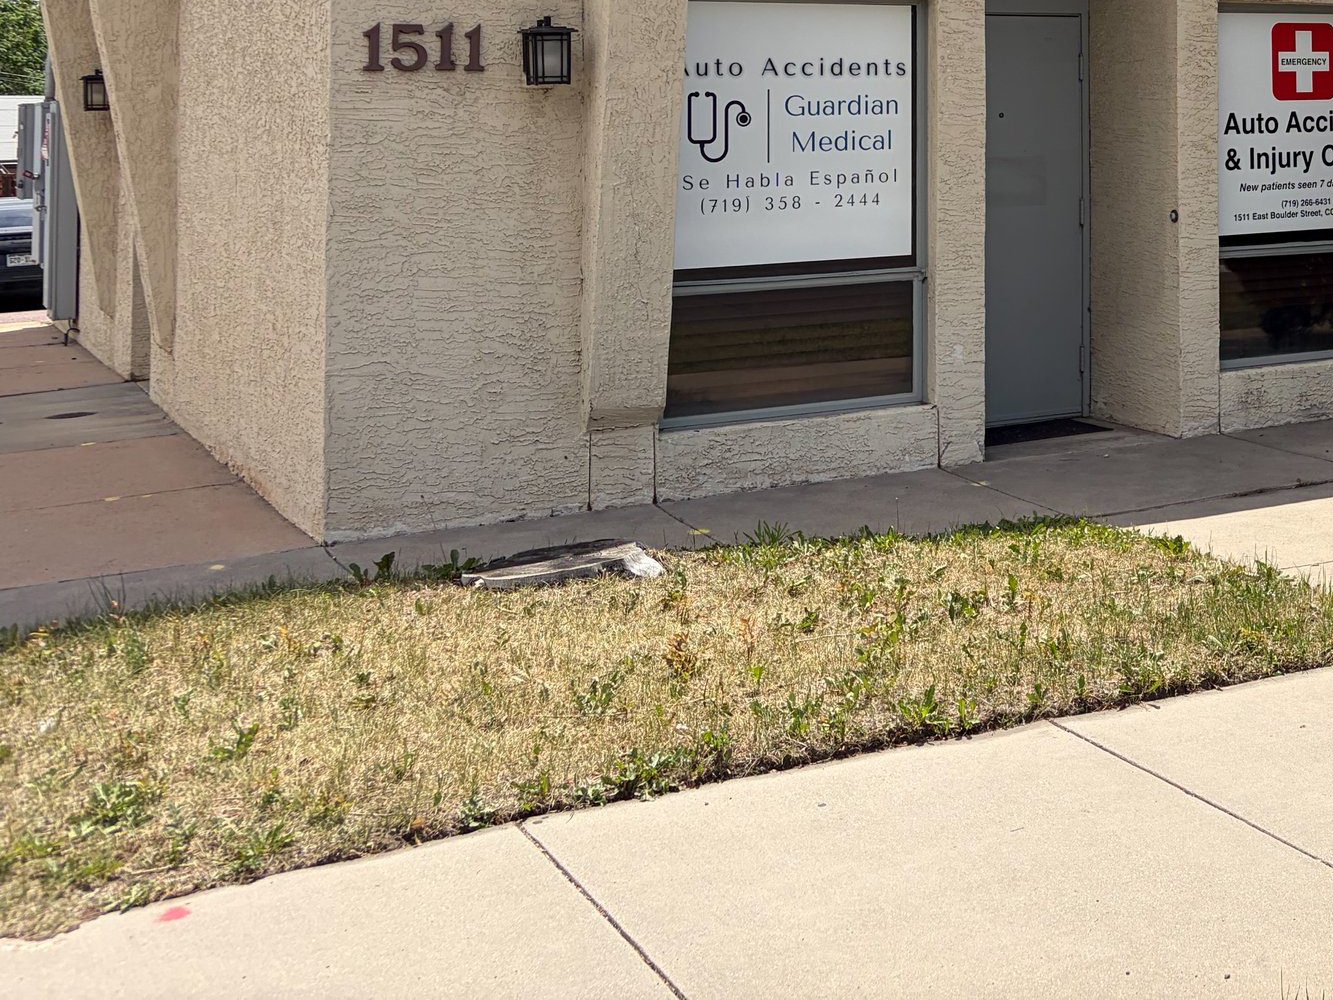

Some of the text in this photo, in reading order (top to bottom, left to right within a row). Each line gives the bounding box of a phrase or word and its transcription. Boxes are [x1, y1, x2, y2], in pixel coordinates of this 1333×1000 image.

[362, 22, 485, 72] 1511
[762, 57, 906, 77] Accidents
[1281, 58, 1327, 66] EMERGENCY
[785, 95, 898, 116] Guardian
[1224, 112, 1278, 135] Auto
[792, 130, 892, 152] Medical
[1225, 148, 1241, 171] &
[1250, 146, 1314, 175] Injury
[682, 169, 897, 190] Se Habla Español
[1239, 183, 1259, 192] New
[1261, 181, 1295, 193] patients
[1297, 181, 1317, 189] seen
[1320, 179, 1325, 188] 7
[700, 196, 750, 215] (719)
[765, 196, 801, 210] 358
[835, 193, 880, 208] 2444
[1281, 199, 1299, 209] (719)
[1234, 213, 1250, 221] 1511
[1252, 212, 1268, 220] East
[1271, 210, 1298, 219] Boulder
[1301, 209, 1323, 218] Street,
